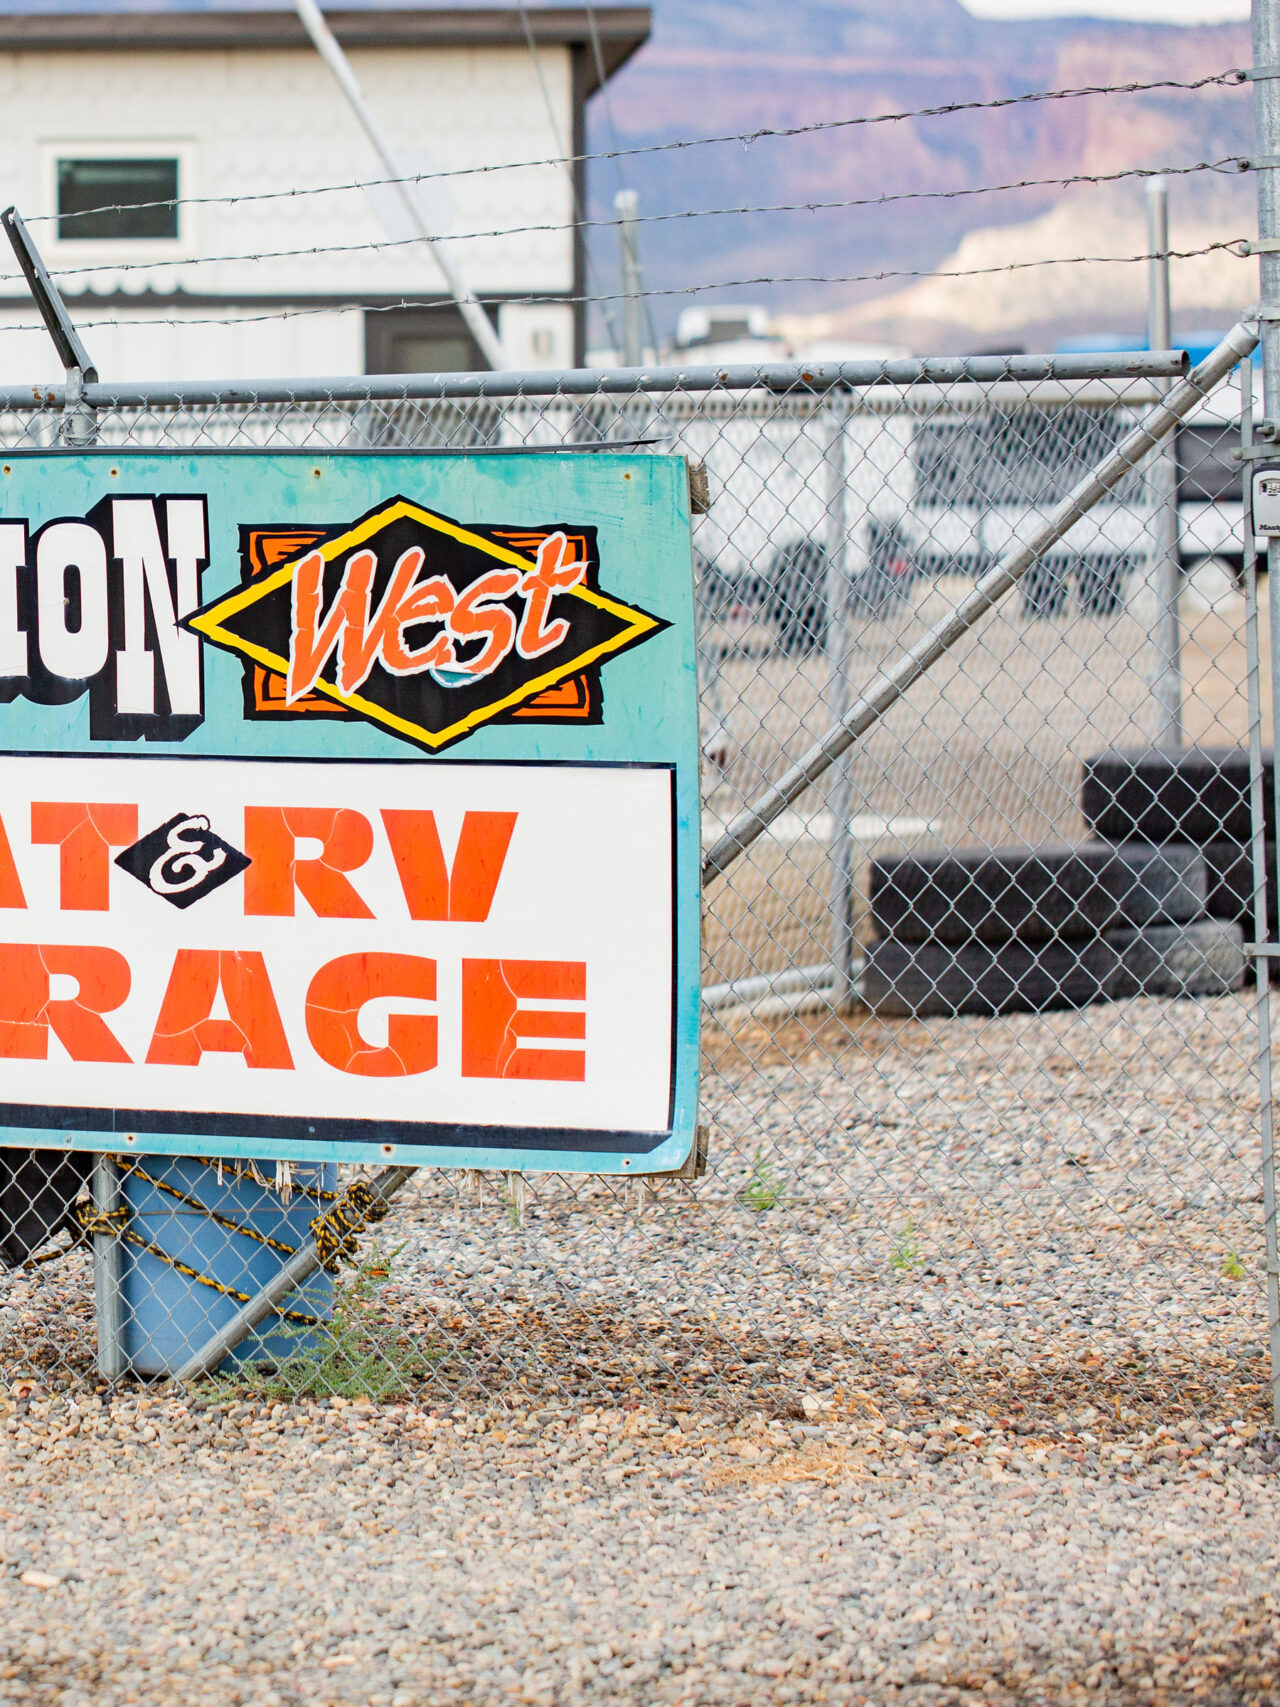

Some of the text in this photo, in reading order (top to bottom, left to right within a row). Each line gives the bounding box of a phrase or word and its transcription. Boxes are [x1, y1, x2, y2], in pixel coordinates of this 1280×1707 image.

[286, 531, 594, 706] West
[149, 814, 227, 895] &
[244, 806, 519, 922] RV
